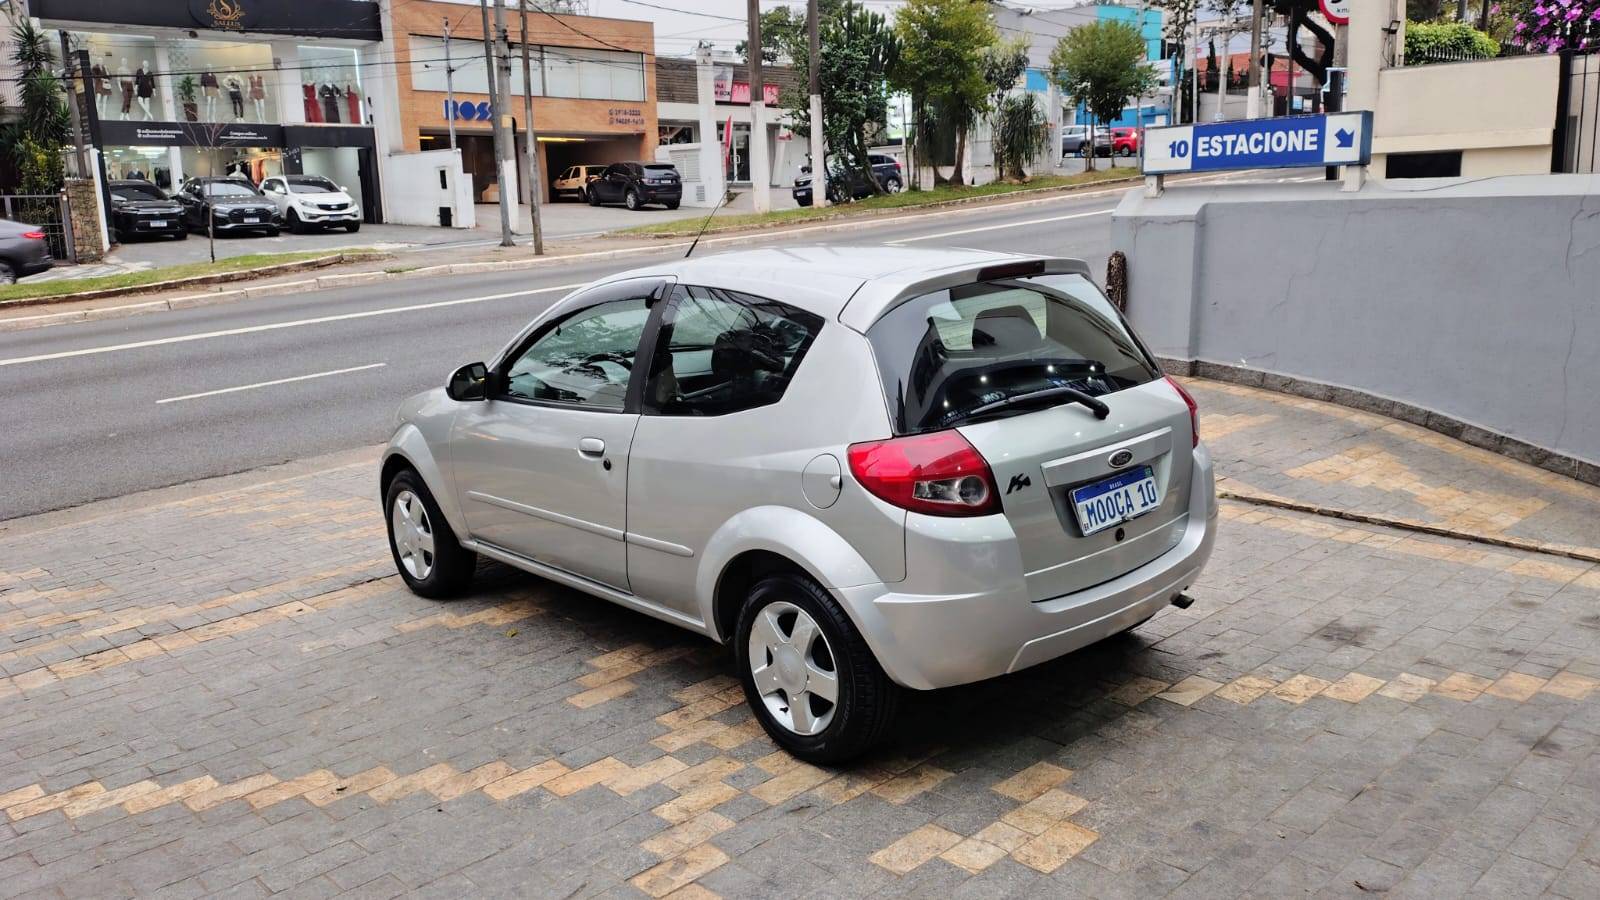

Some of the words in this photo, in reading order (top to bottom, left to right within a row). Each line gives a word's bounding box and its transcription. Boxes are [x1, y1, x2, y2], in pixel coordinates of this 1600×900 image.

[1169, 140, 1189, 159] 10
[1197, 129, 1319, 157] ESTACIONE
[1085, 489, 1135, 527] MOOCA
[1137, 480, 1157, 508] 10
